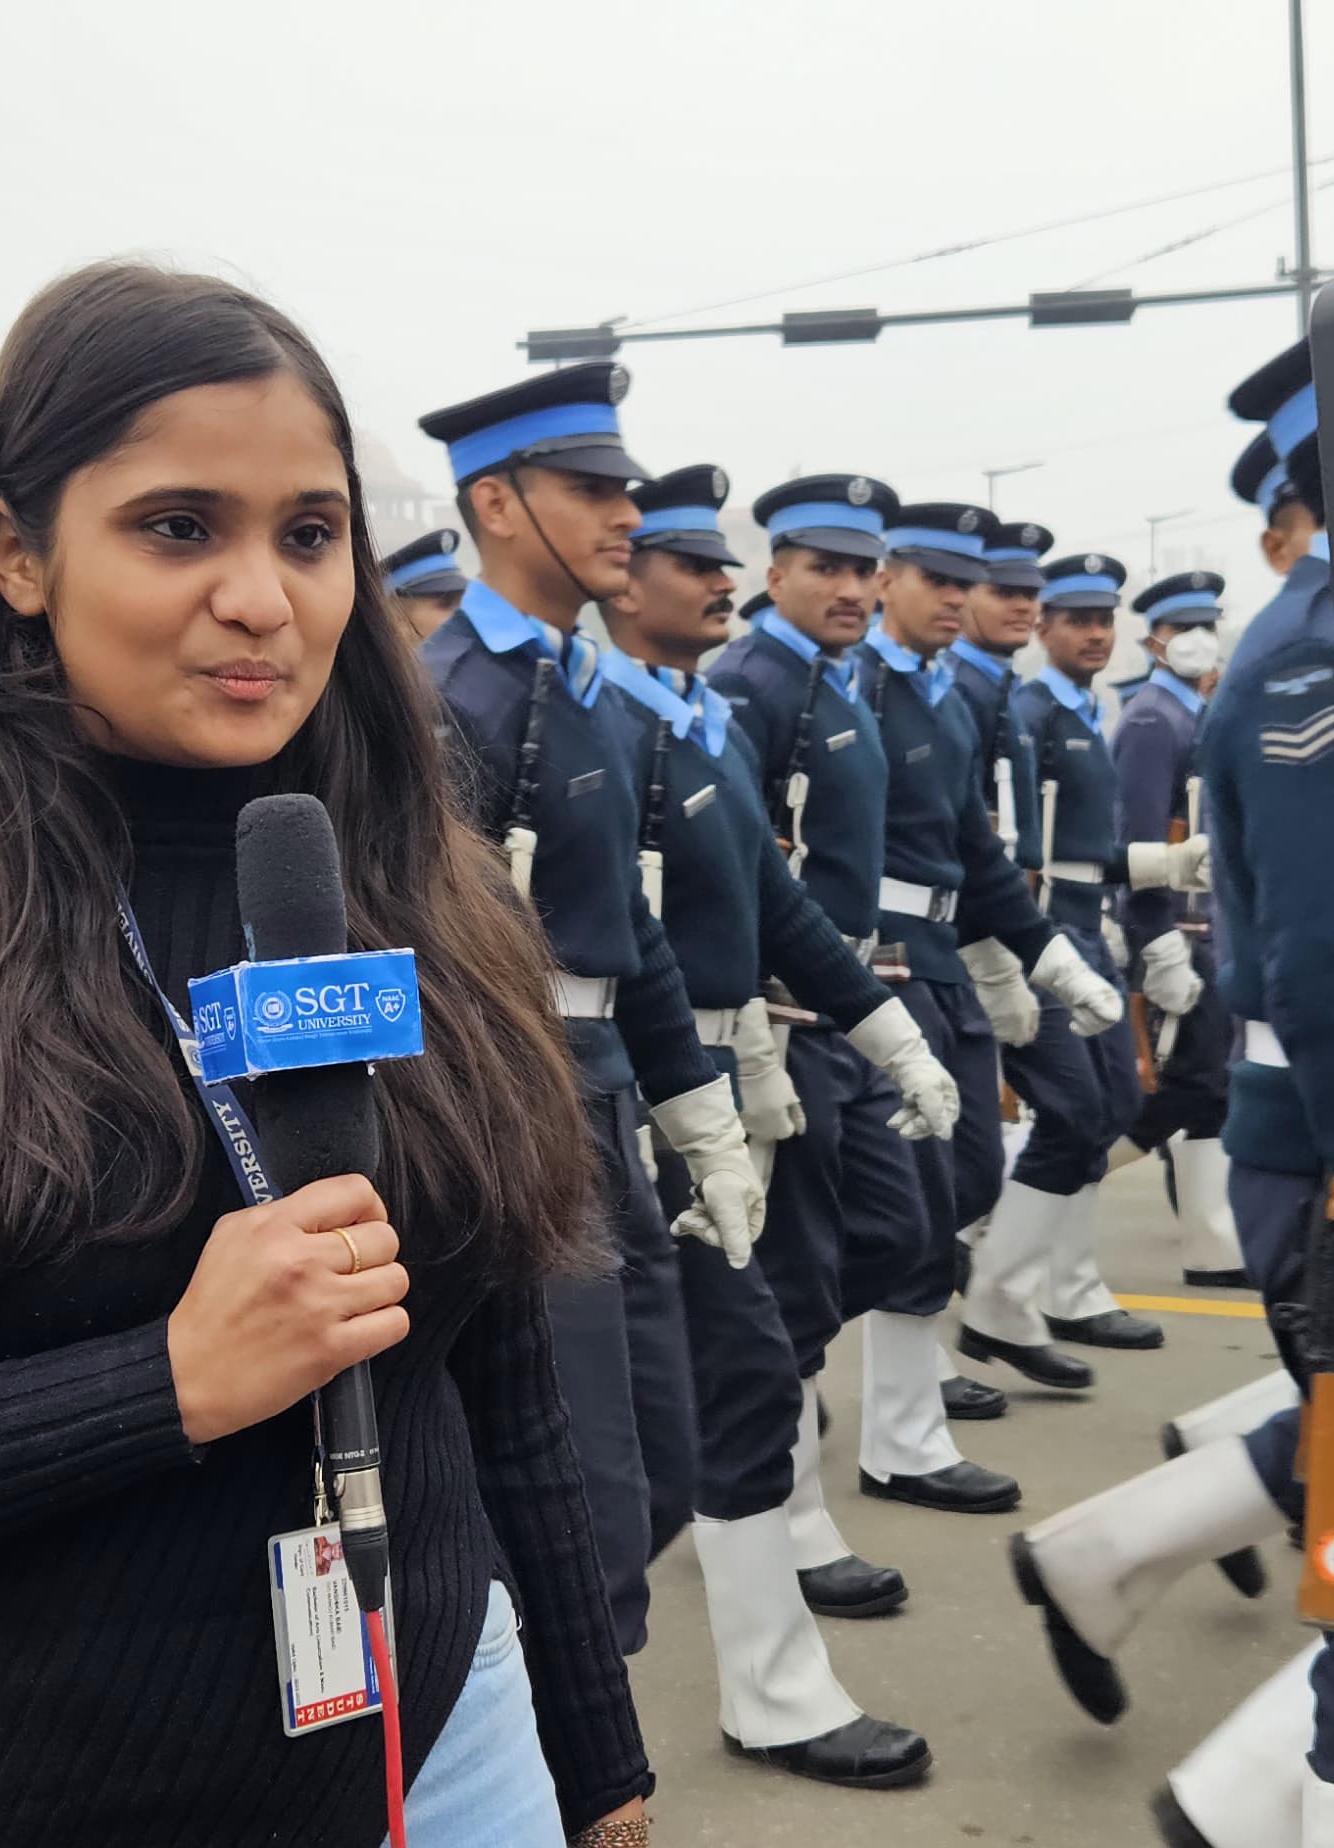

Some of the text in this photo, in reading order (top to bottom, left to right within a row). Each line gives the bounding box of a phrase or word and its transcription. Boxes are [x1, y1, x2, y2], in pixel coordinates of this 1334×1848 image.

[295, 982, 370, 1016] SGT
[384, 1002, 400, 1014] A+
[198, 1001, 222, 1034] SGT
[298, 1012, 372, 1031] UNIVERSITY
[297, 1692, 364, 1724] STUDENT
